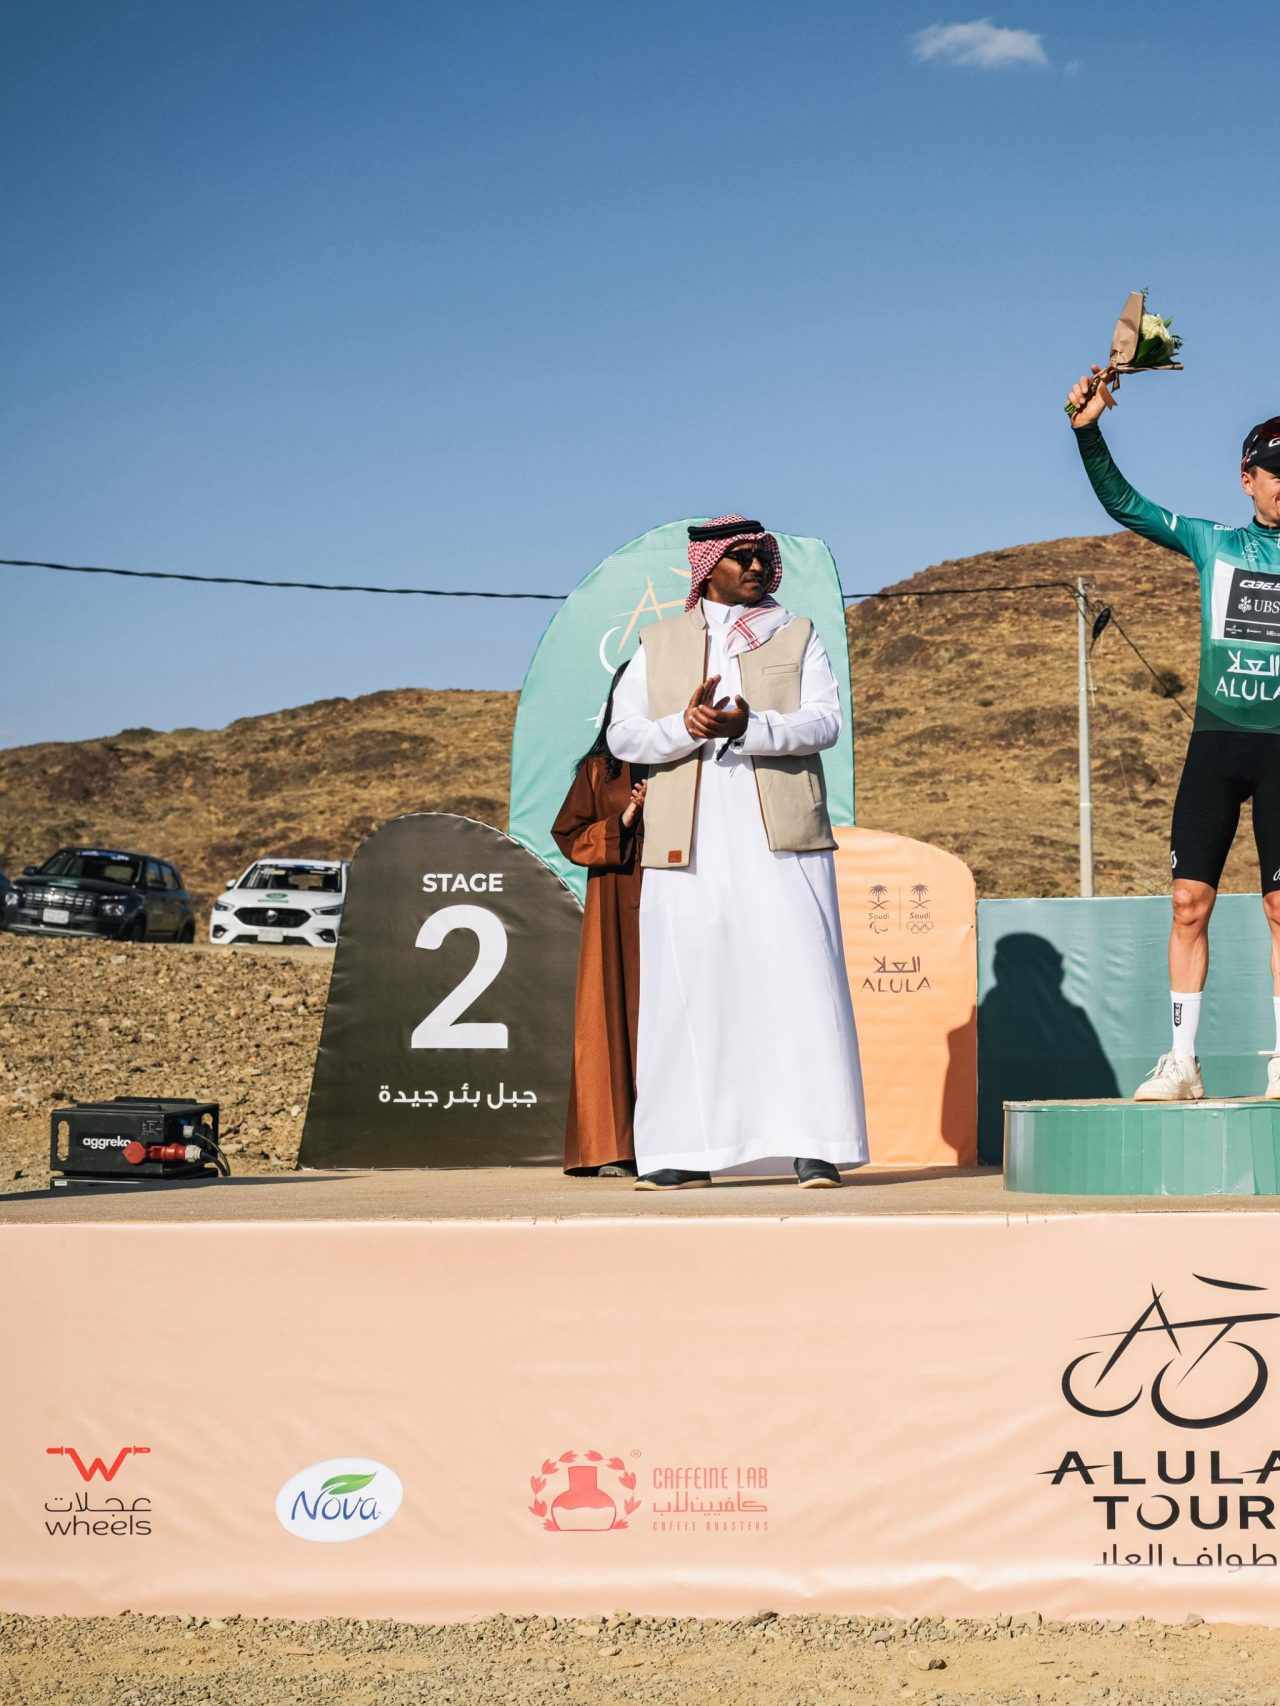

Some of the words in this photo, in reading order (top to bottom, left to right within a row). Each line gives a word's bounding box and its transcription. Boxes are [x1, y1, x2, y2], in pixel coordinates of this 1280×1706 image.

[1254, 599, 1280, 614] UBS
[422, 873, 504, 893] STAGE
[909, 912, 931, 920] Saudi
[410, 904, 509, 1049] 2
[860, 976, 932, 994] ALULA
[378, 1084, 439, 1108] جيدة
[443, 1083, 481, 1109] بئر
[487, 1082, 537, 1109] جبل
[82, 1135, 132, 1150] aggreko
[652, 1467, 729, 1489] CAFFEINE
[737, 1466, 769, 1489] LAB
[44, 1491, 152, 1518] عجلات
[291, 1485, 379, 1521] Nova
[1093, 1494, 1277, 1531] TOUR
[45, 1514, 152, 1536] wheels
[652, 1520, 697, 1532] COFFEE
[706, 1520, 769, 1532] ROASTERS
[1172, 1543, 1278, 1574] طواف
